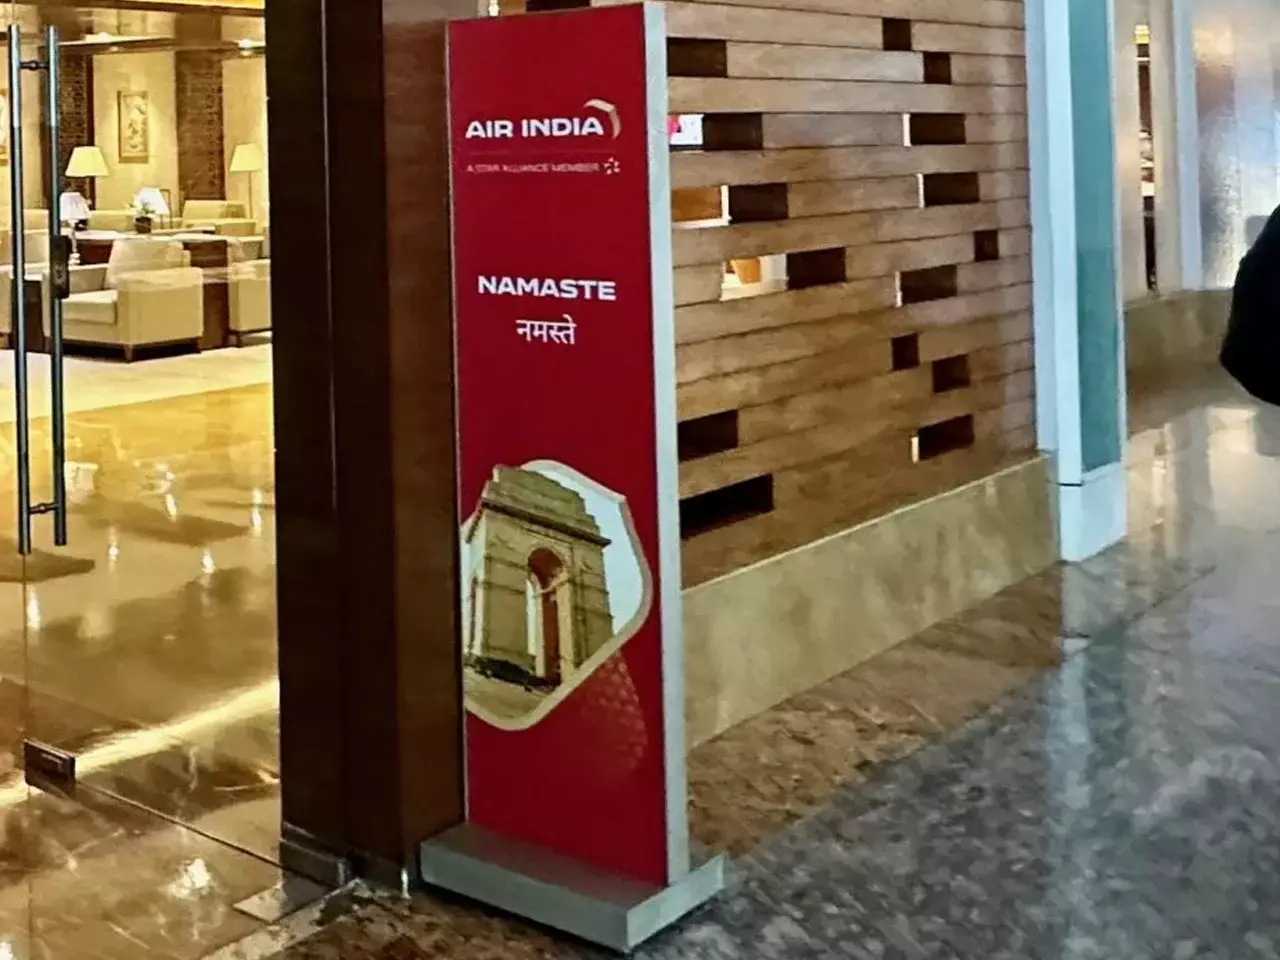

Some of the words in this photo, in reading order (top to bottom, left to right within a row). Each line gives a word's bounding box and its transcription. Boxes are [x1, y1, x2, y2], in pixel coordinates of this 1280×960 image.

[465, 120, 514, 138] AIR
[521, 117, 605, 137] INDIA
[552, 162, 600, 172] MEMBER
[477, 275, 617, 301] NAMASTE
[515, 313, 577, 345] नमस्ते
